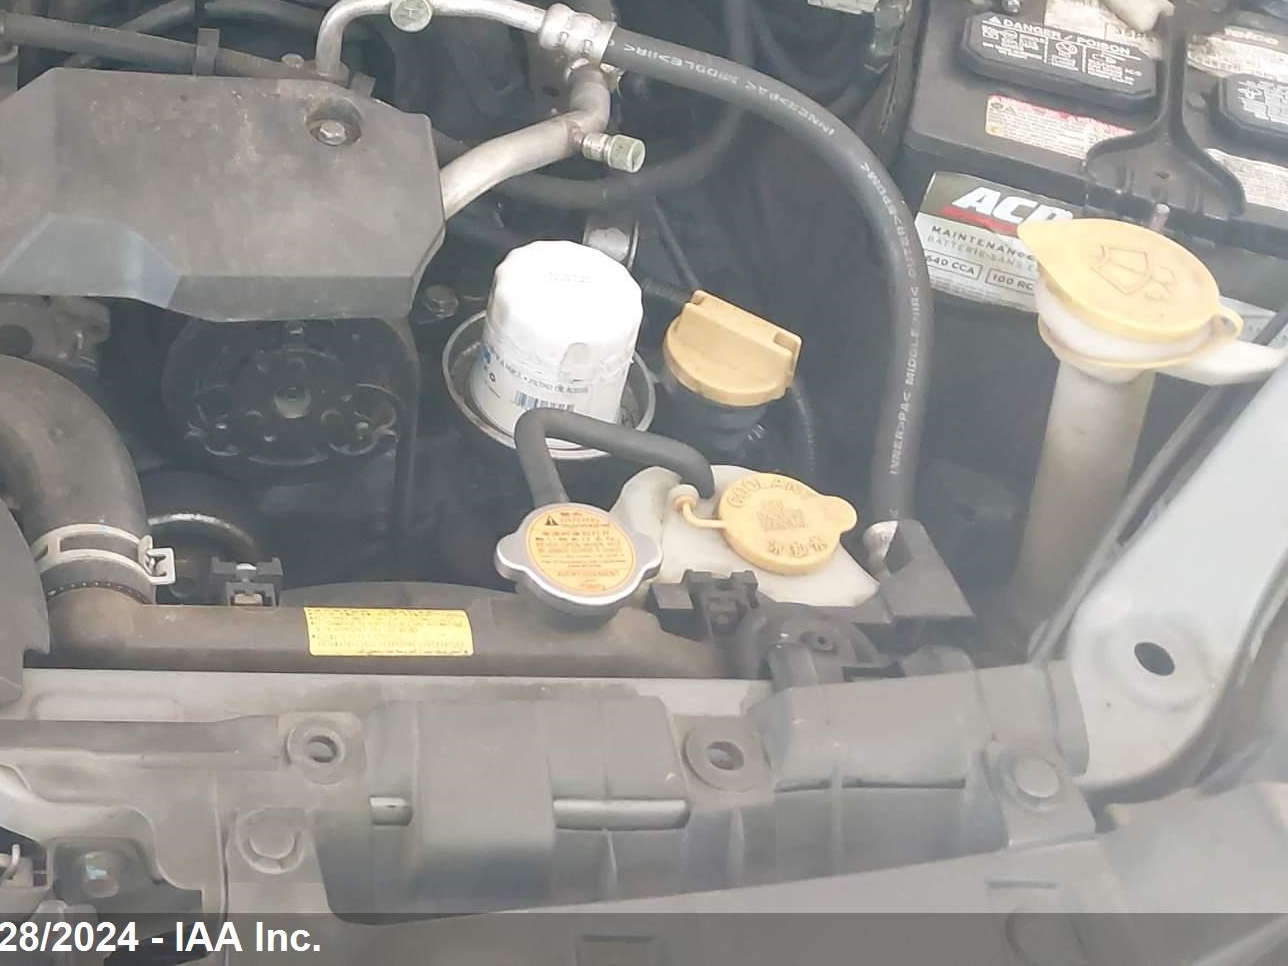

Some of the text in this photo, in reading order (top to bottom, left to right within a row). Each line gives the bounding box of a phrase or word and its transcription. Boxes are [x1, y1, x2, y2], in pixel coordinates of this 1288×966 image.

[1003, 18, 1061, 40] DANGER
[1076, 36, 1130, 56] POISON
[951, 262, 976, 275] CCA
[992, 274, 1015, 285] 100
